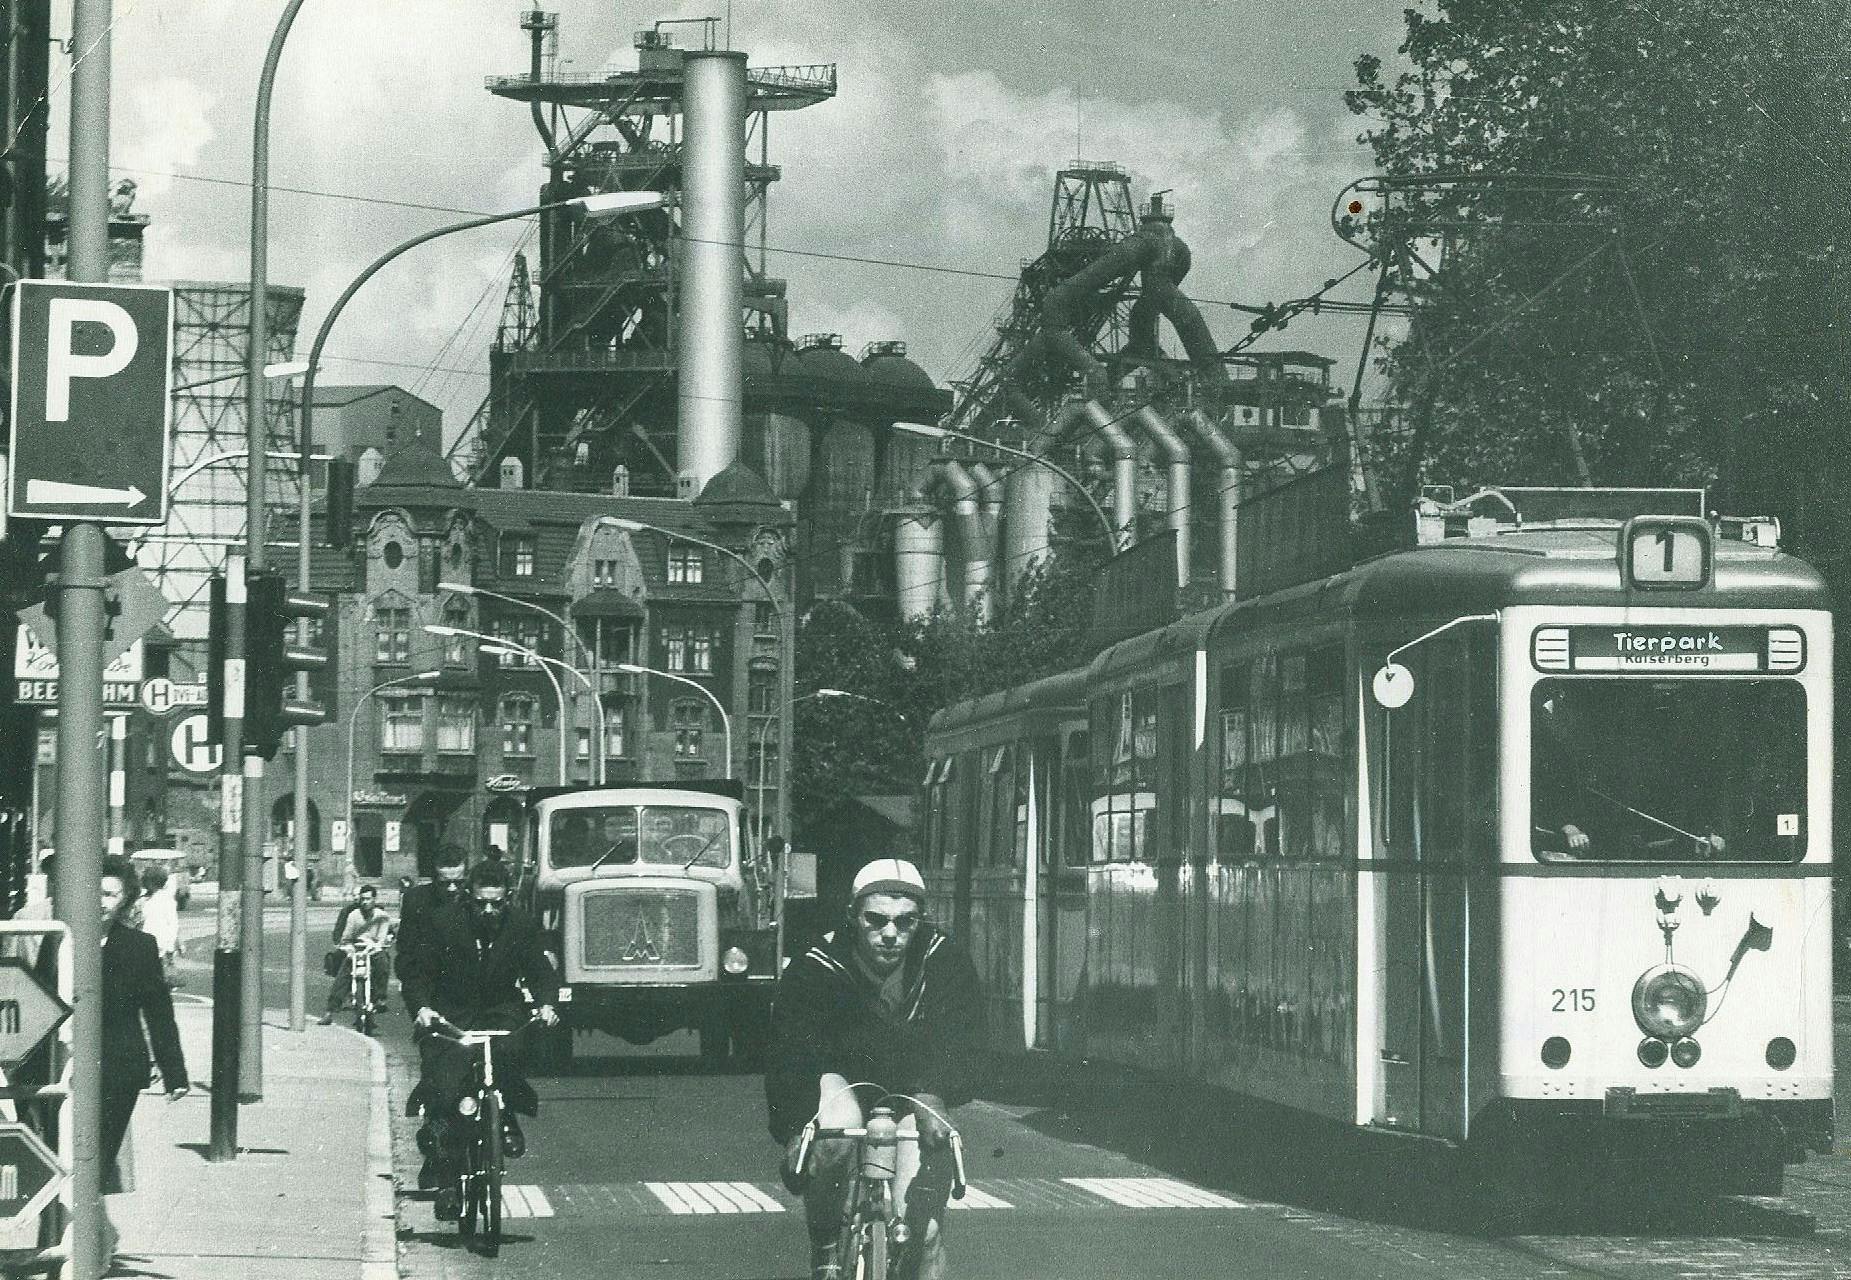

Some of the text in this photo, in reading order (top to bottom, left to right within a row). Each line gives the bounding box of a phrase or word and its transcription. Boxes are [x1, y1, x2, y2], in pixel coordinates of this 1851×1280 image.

[46, 298, 139, 422] P
[1655, 530, 1675, 572] 1
[1613, 631, 1724, 652] Tierpark
[1551, 988, 1596, 1012] 215
